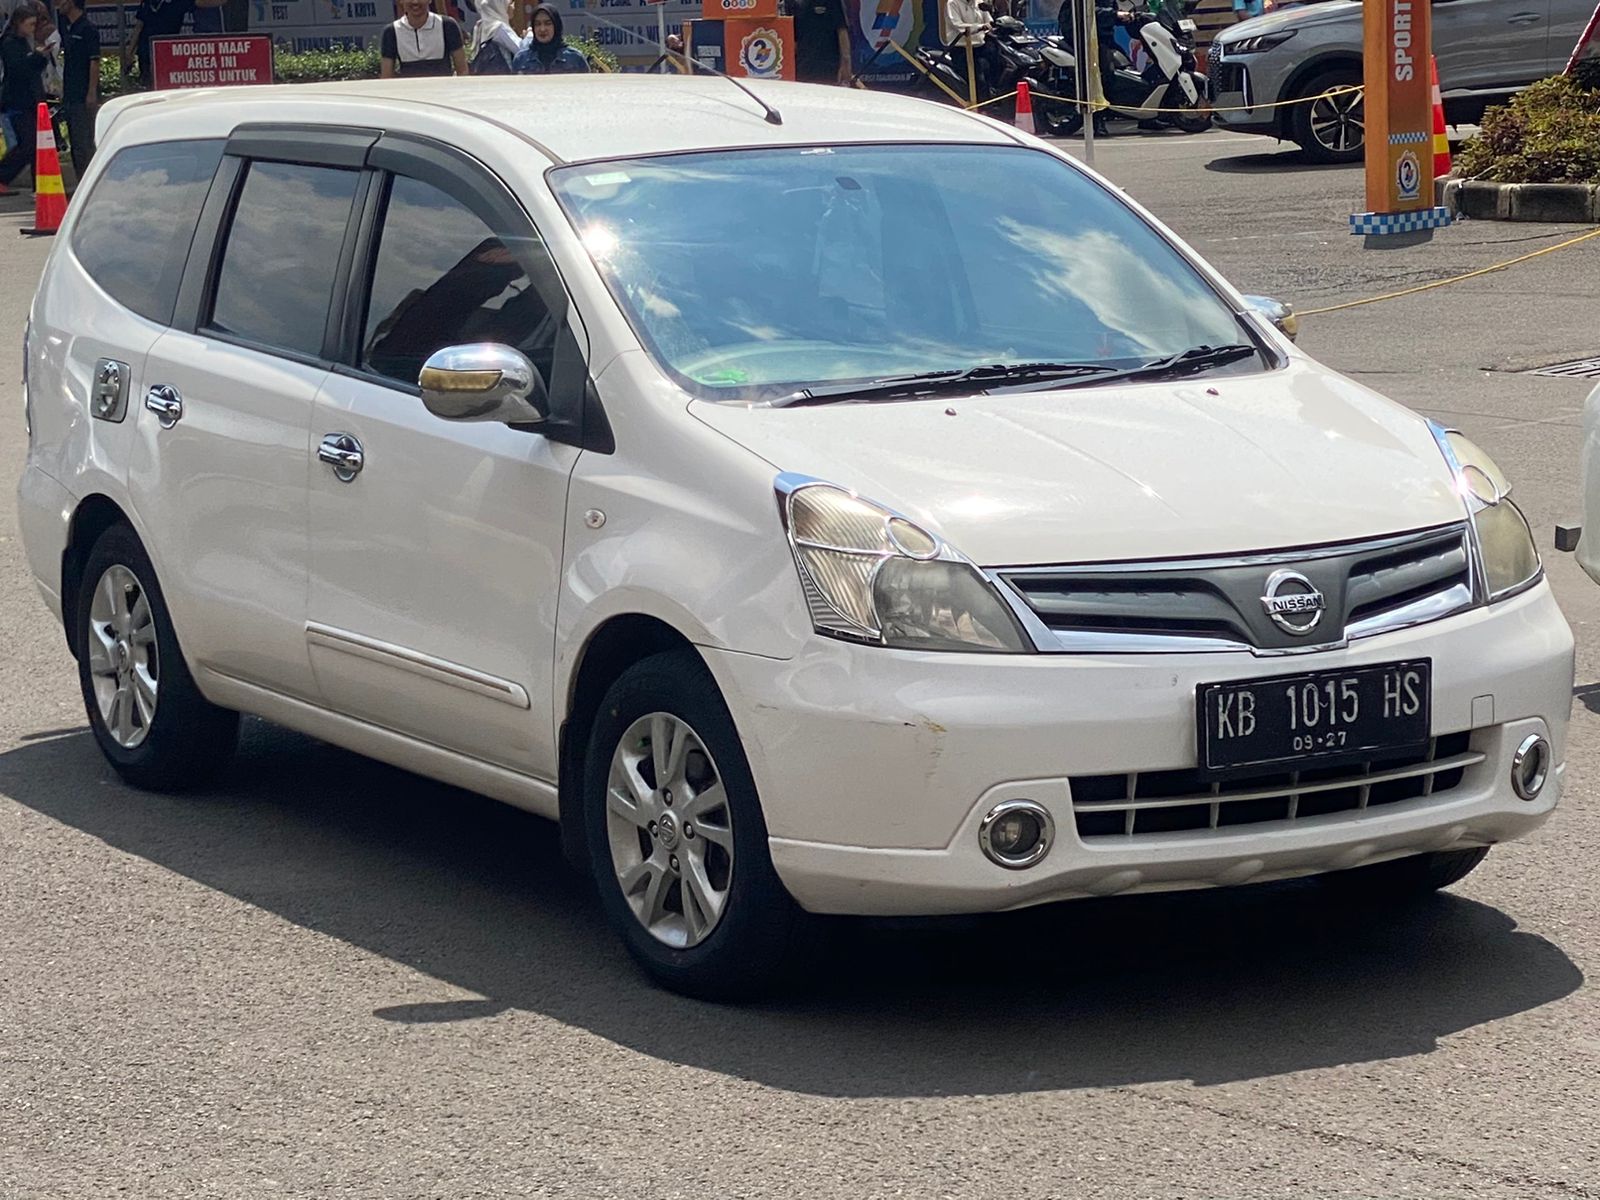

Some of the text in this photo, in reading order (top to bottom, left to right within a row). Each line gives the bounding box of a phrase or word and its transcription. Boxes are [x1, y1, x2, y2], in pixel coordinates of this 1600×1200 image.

[172, 41, 251, 55] MOHON MAAF
[1394, 0, 1413, 81] SPORT
[187, 57, 237, 69] AREA INI
[169, 68, 257, 84] KHUSUS UNTUK
[1272, 594, 1321, 612] NISSAN
[1217, 671, 1420, 739] KB 1015 HS
